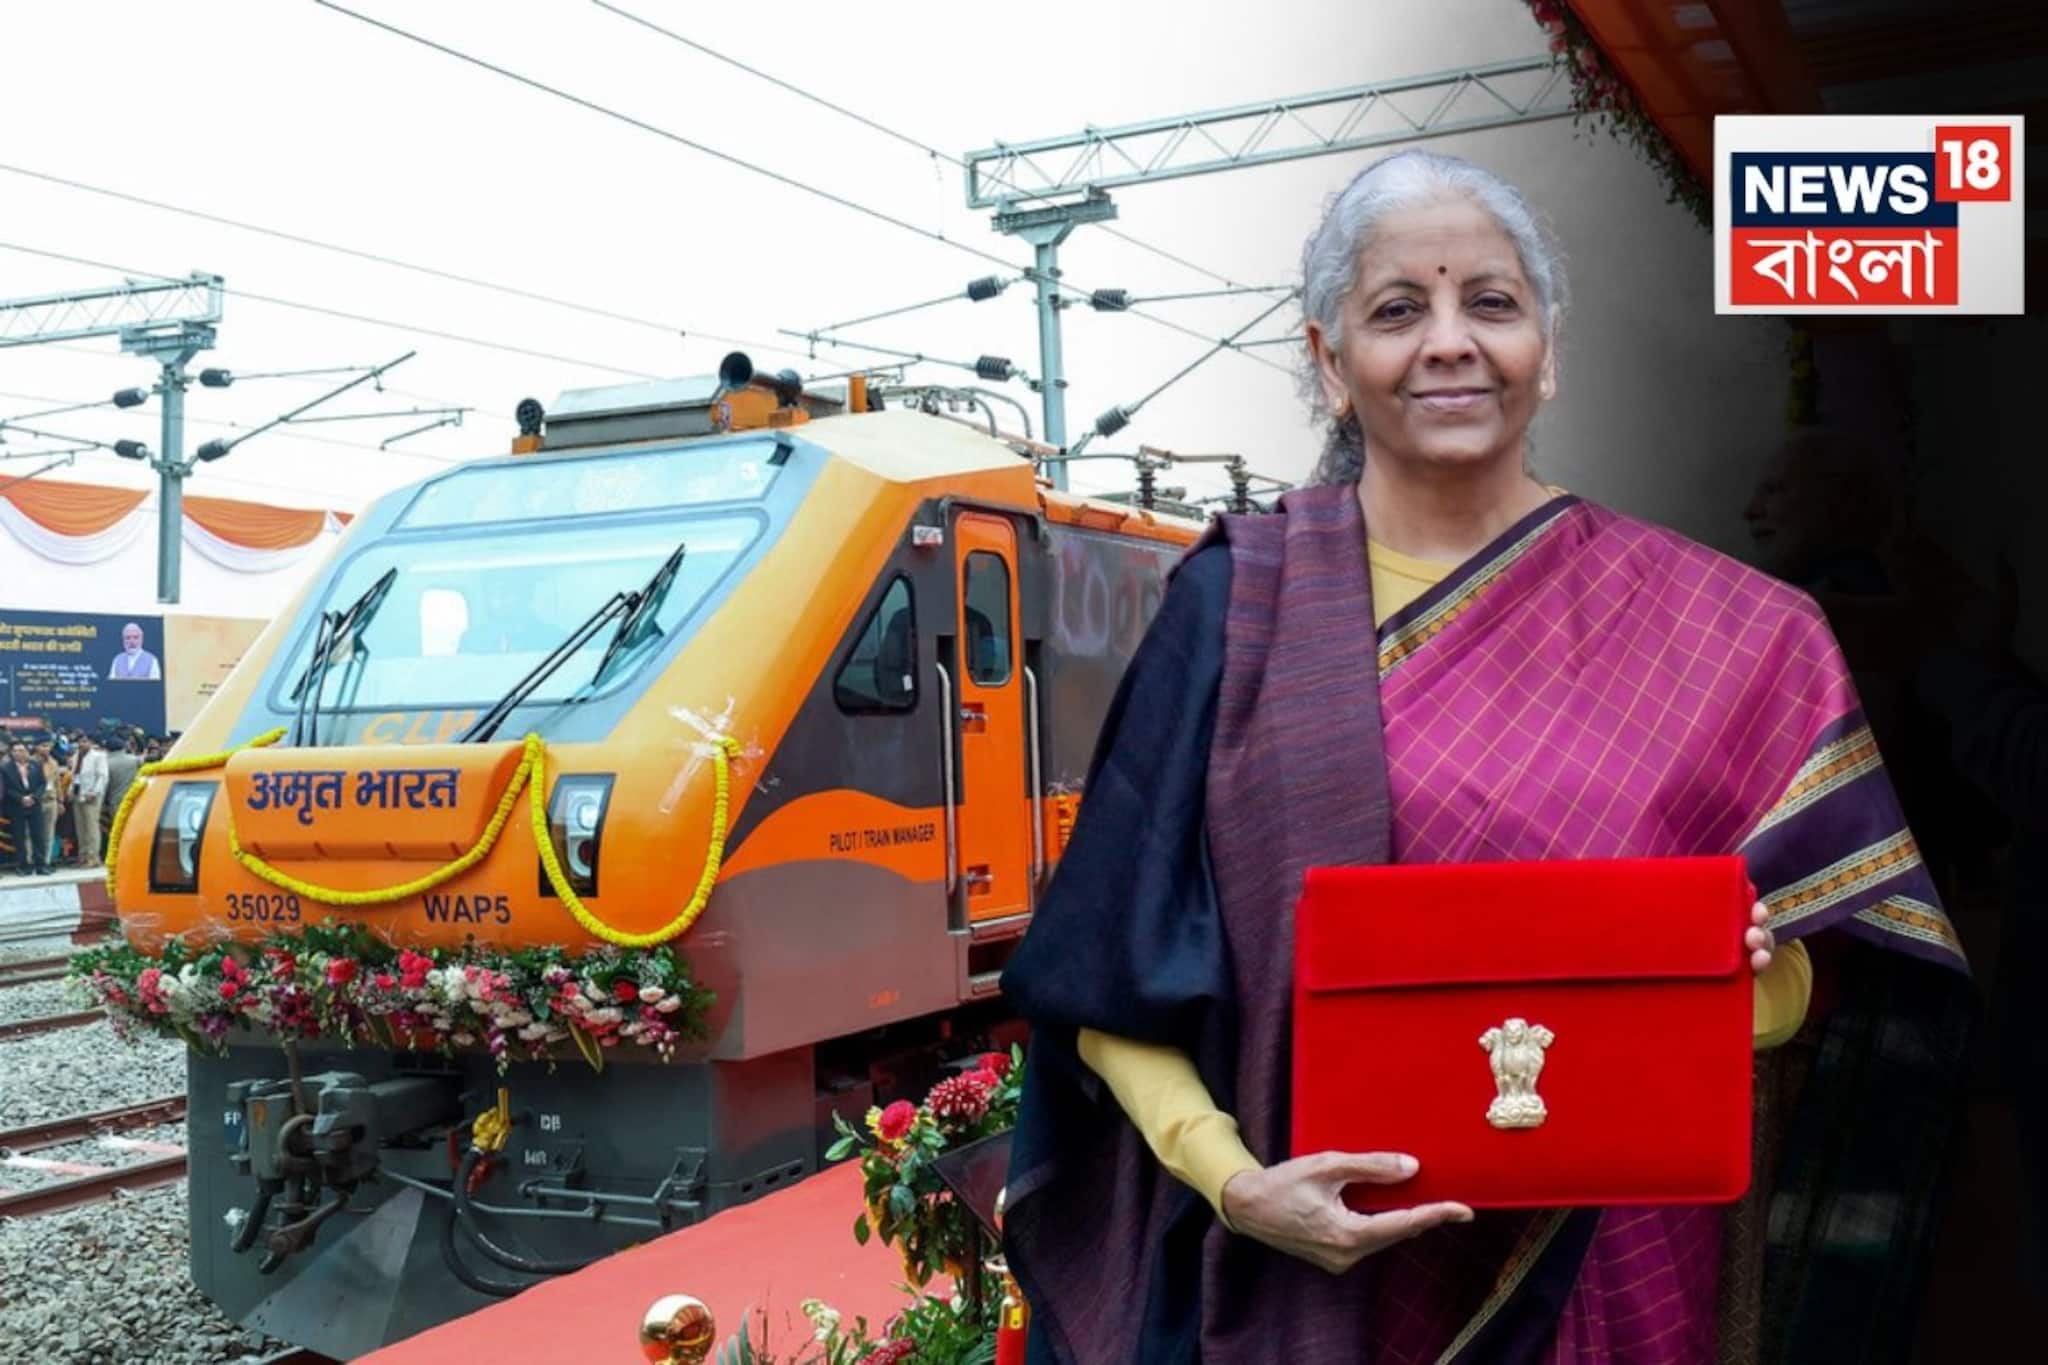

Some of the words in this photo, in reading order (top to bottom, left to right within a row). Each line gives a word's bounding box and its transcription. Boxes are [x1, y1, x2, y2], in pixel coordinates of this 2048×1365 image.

[248, 768, 346, 826] अमृत
[354, 768, 461, 809] भारत
[829, 832, 857, 852] PILOT
[226, 893, 301, 922] 35029
[424, 895, 511, 924] WAP5
